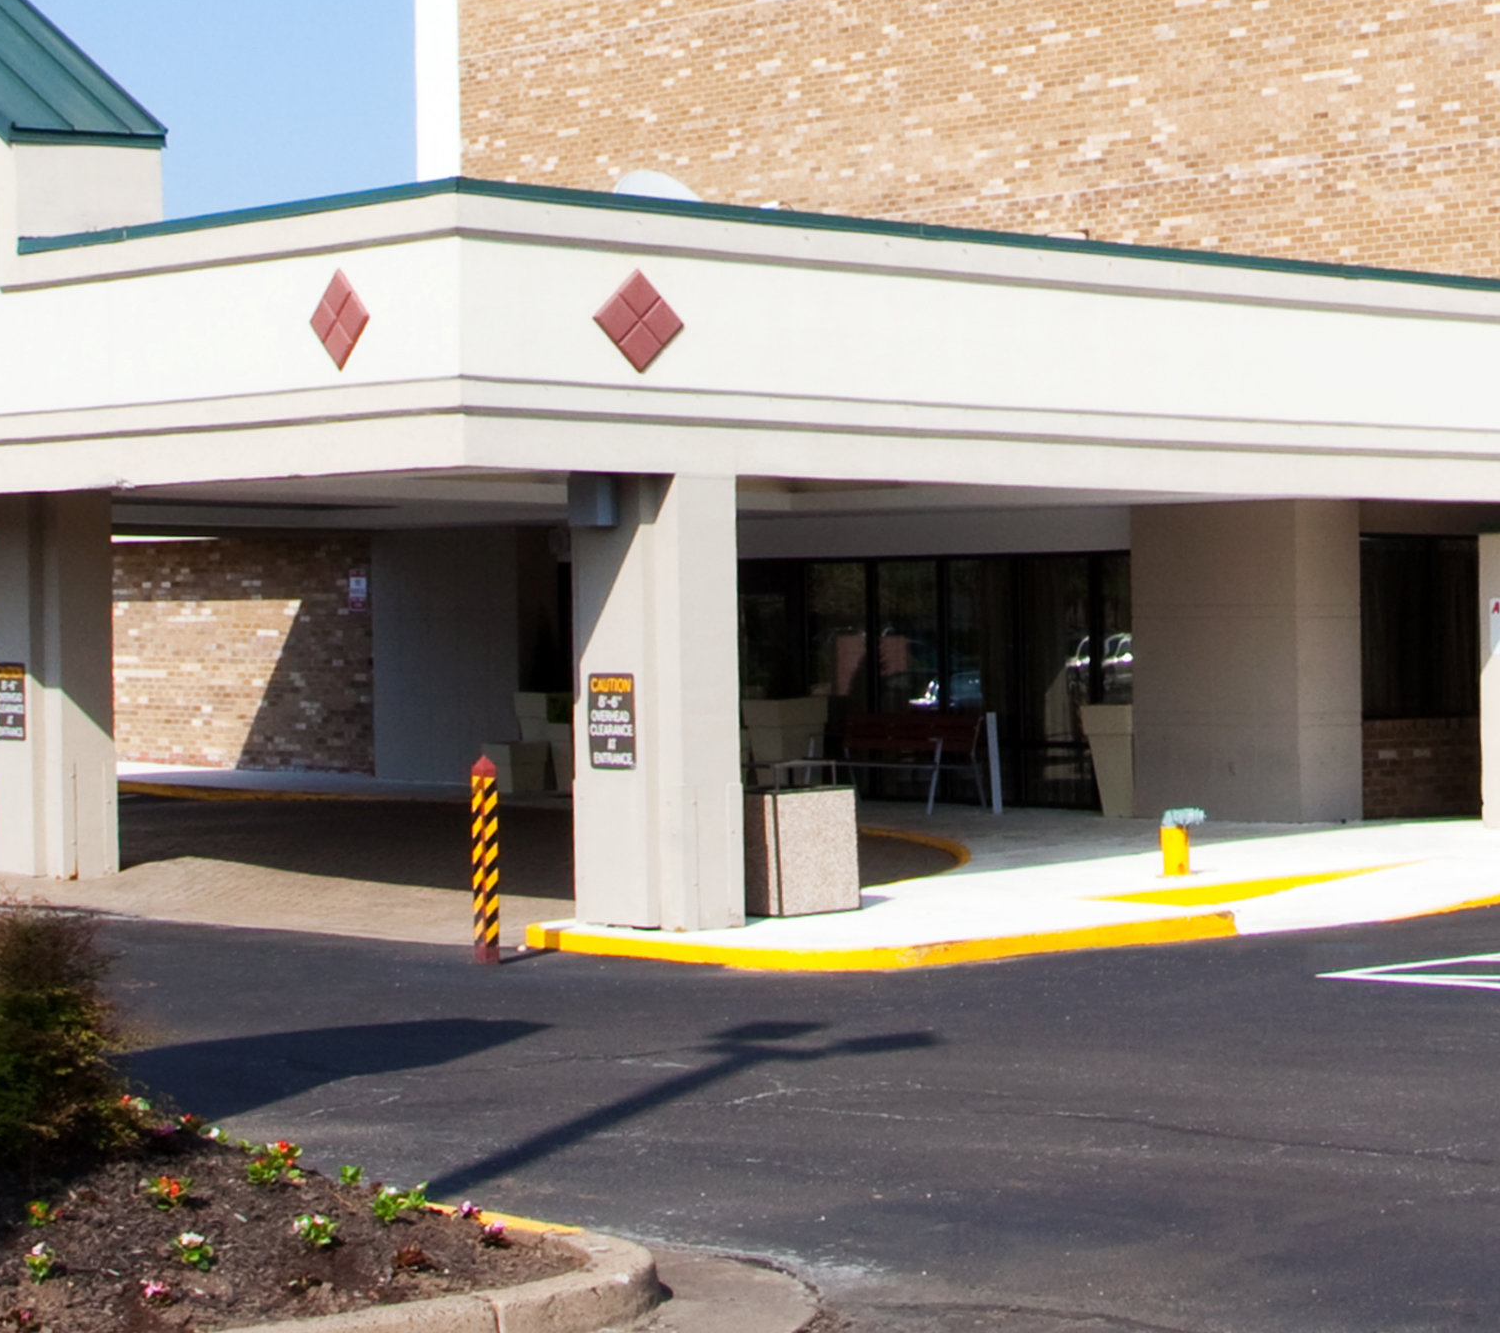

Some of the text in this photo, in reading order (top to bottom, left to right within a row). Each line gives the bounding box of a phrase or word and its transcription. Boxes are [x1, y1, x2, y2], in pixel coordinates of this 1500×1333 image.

[590, 677, 632, 693] CAUTION
[590, 709, 630, 723] OVERHEAD
[590, 723, 633, 737] CLEARANCE
[593, 751, 634, 766] ENTRANCE
